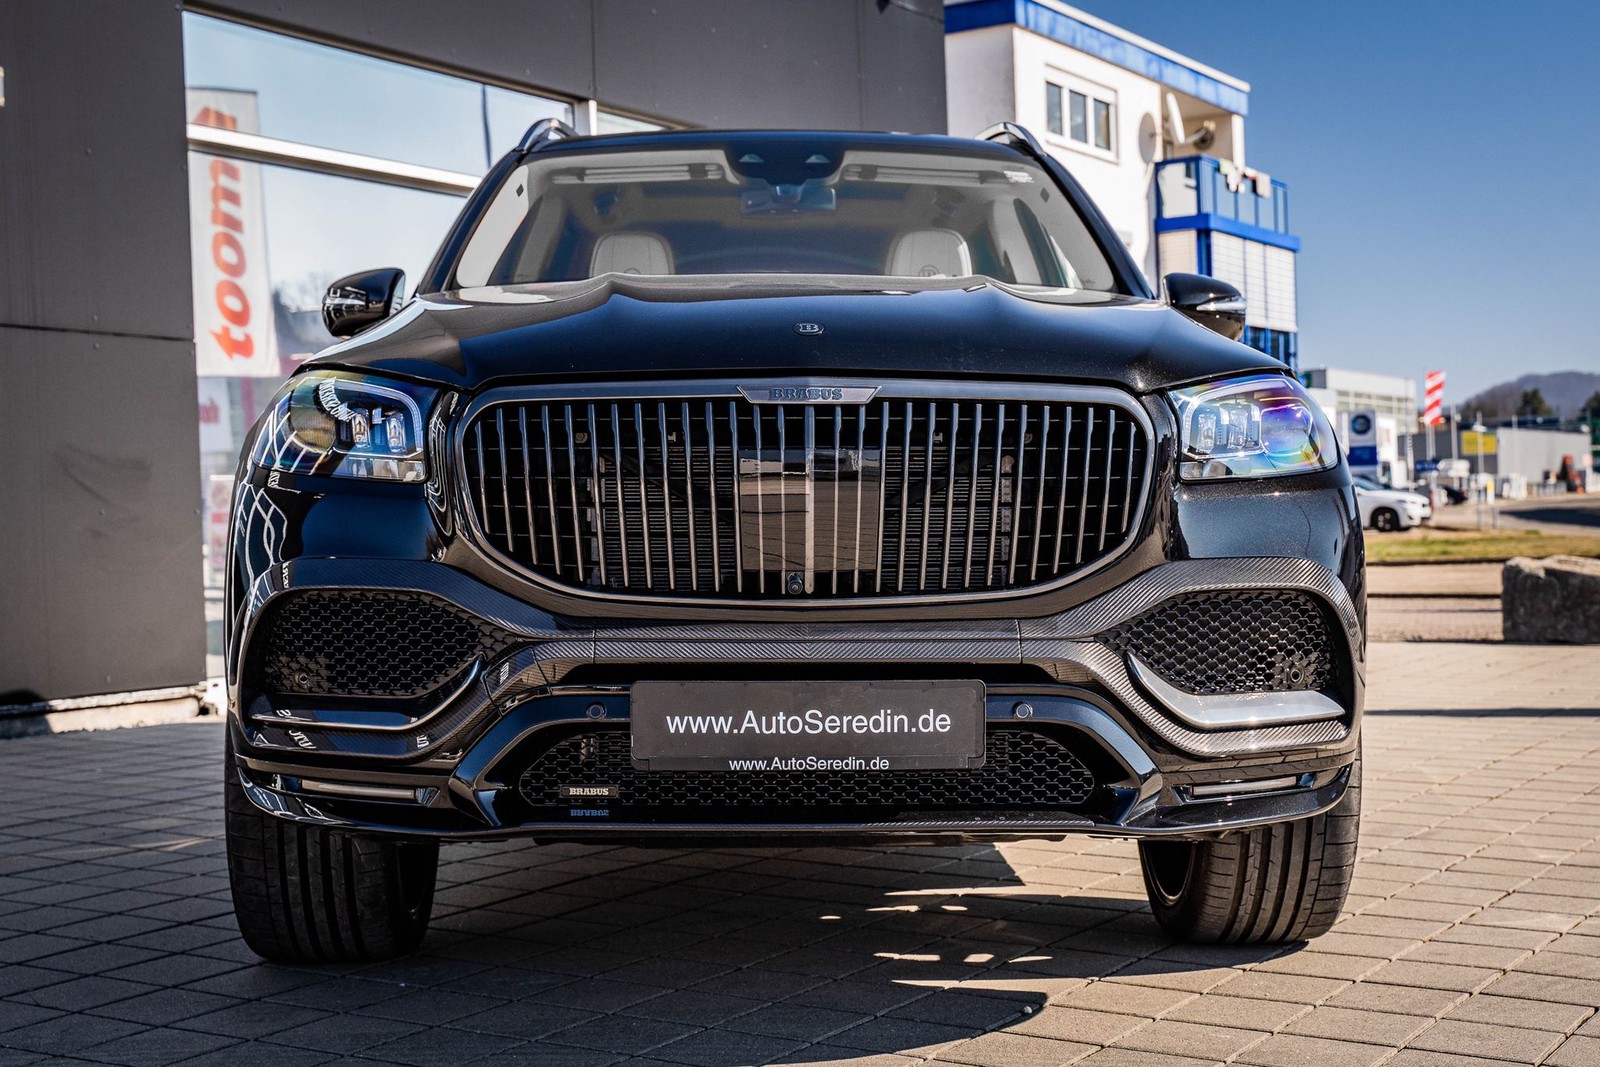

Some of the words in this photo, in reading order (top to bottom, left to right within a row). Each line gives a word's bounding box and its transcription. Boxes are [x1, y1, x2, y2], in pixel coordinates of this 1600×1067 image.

[210, 157, 255, 361] toom
[769, 388, 842, 400] BRABUS
[665, 708, 952, 735] www.AutoSeredin.de
[728, 757, 890, 771] www.AutoSeredin.de
[569, 787, 609, 796] BRABUS
